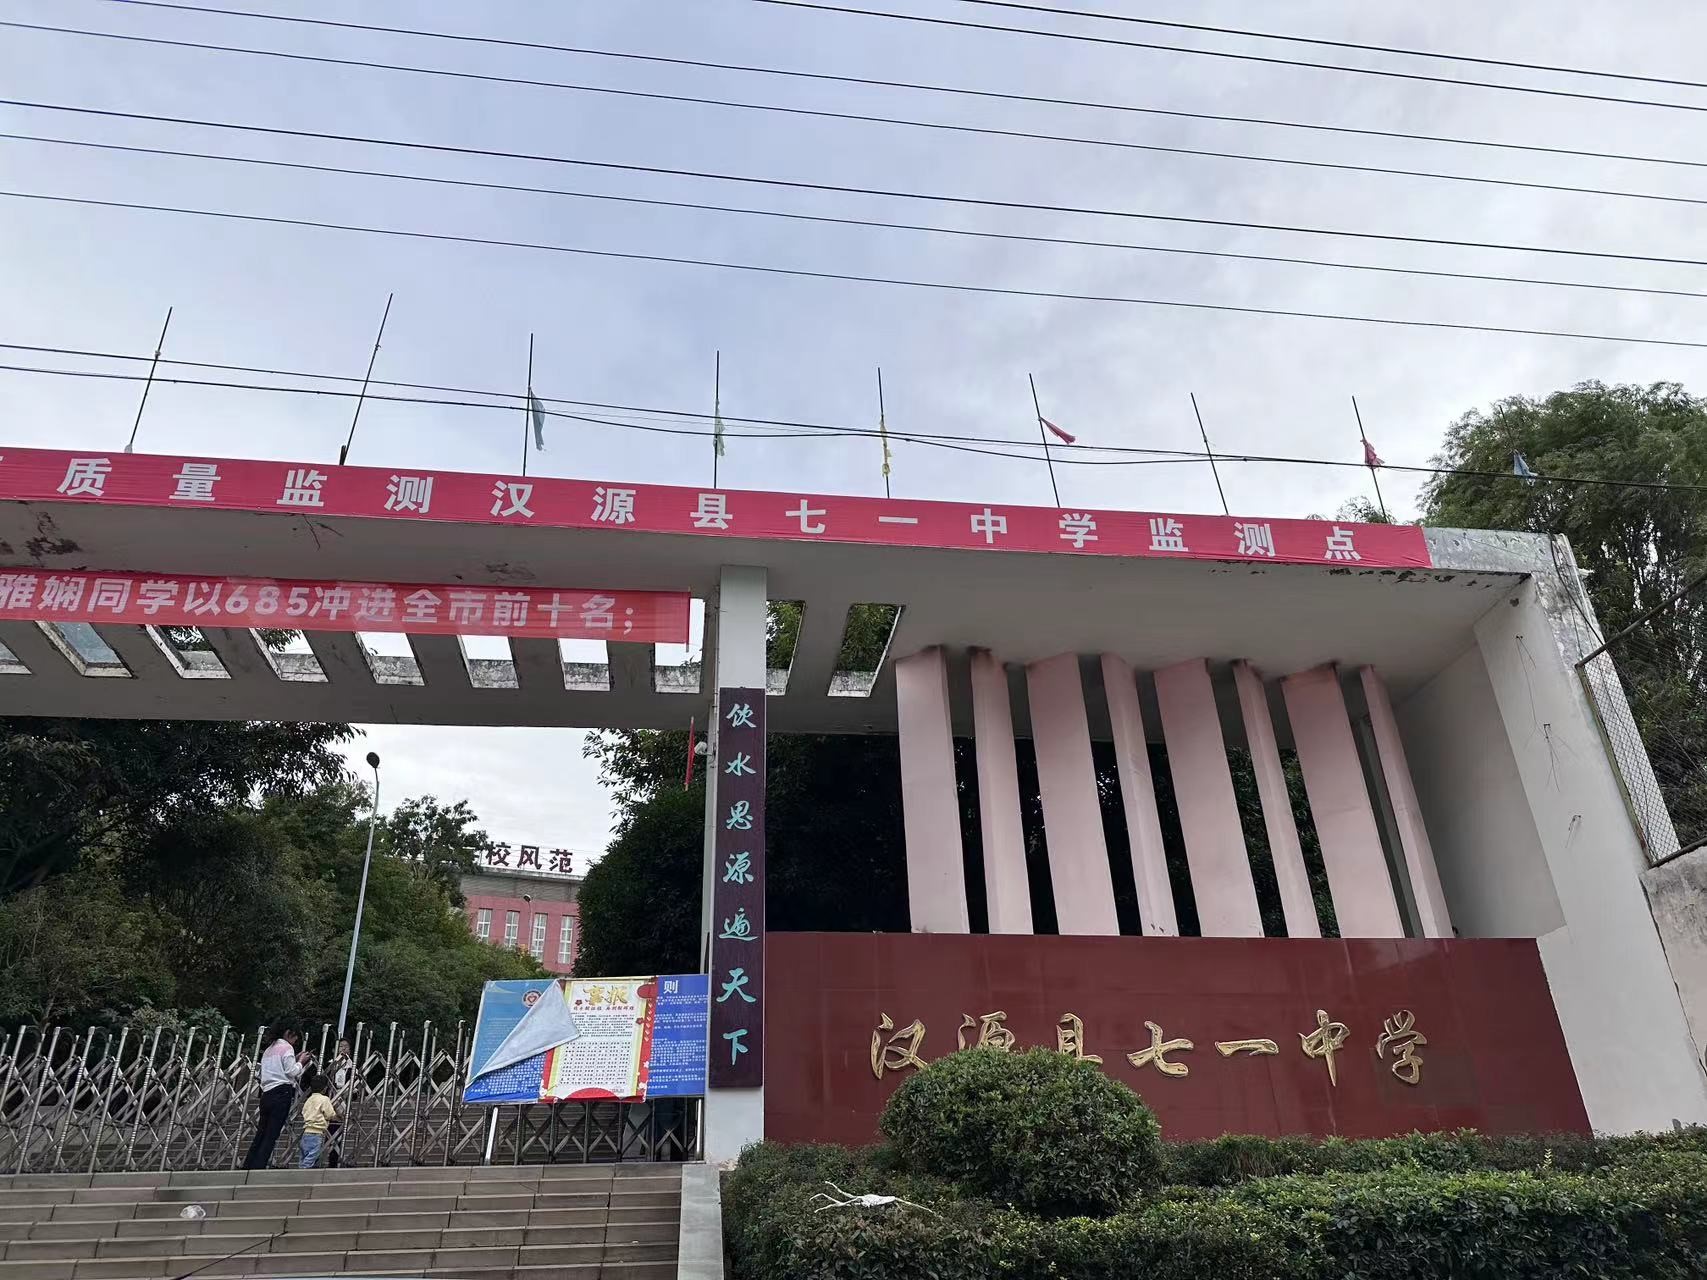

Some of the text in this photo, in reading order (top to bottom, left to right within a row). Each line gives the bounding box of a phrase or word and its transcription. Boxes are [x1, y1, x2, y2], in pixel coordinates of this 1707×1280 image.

[0, 455, 1360, 561] 质量监测汉源县七一中学监测点
[717, 703, 757, 1065] 饮水思源遍天下
[663, 980, 679, 994] 则
